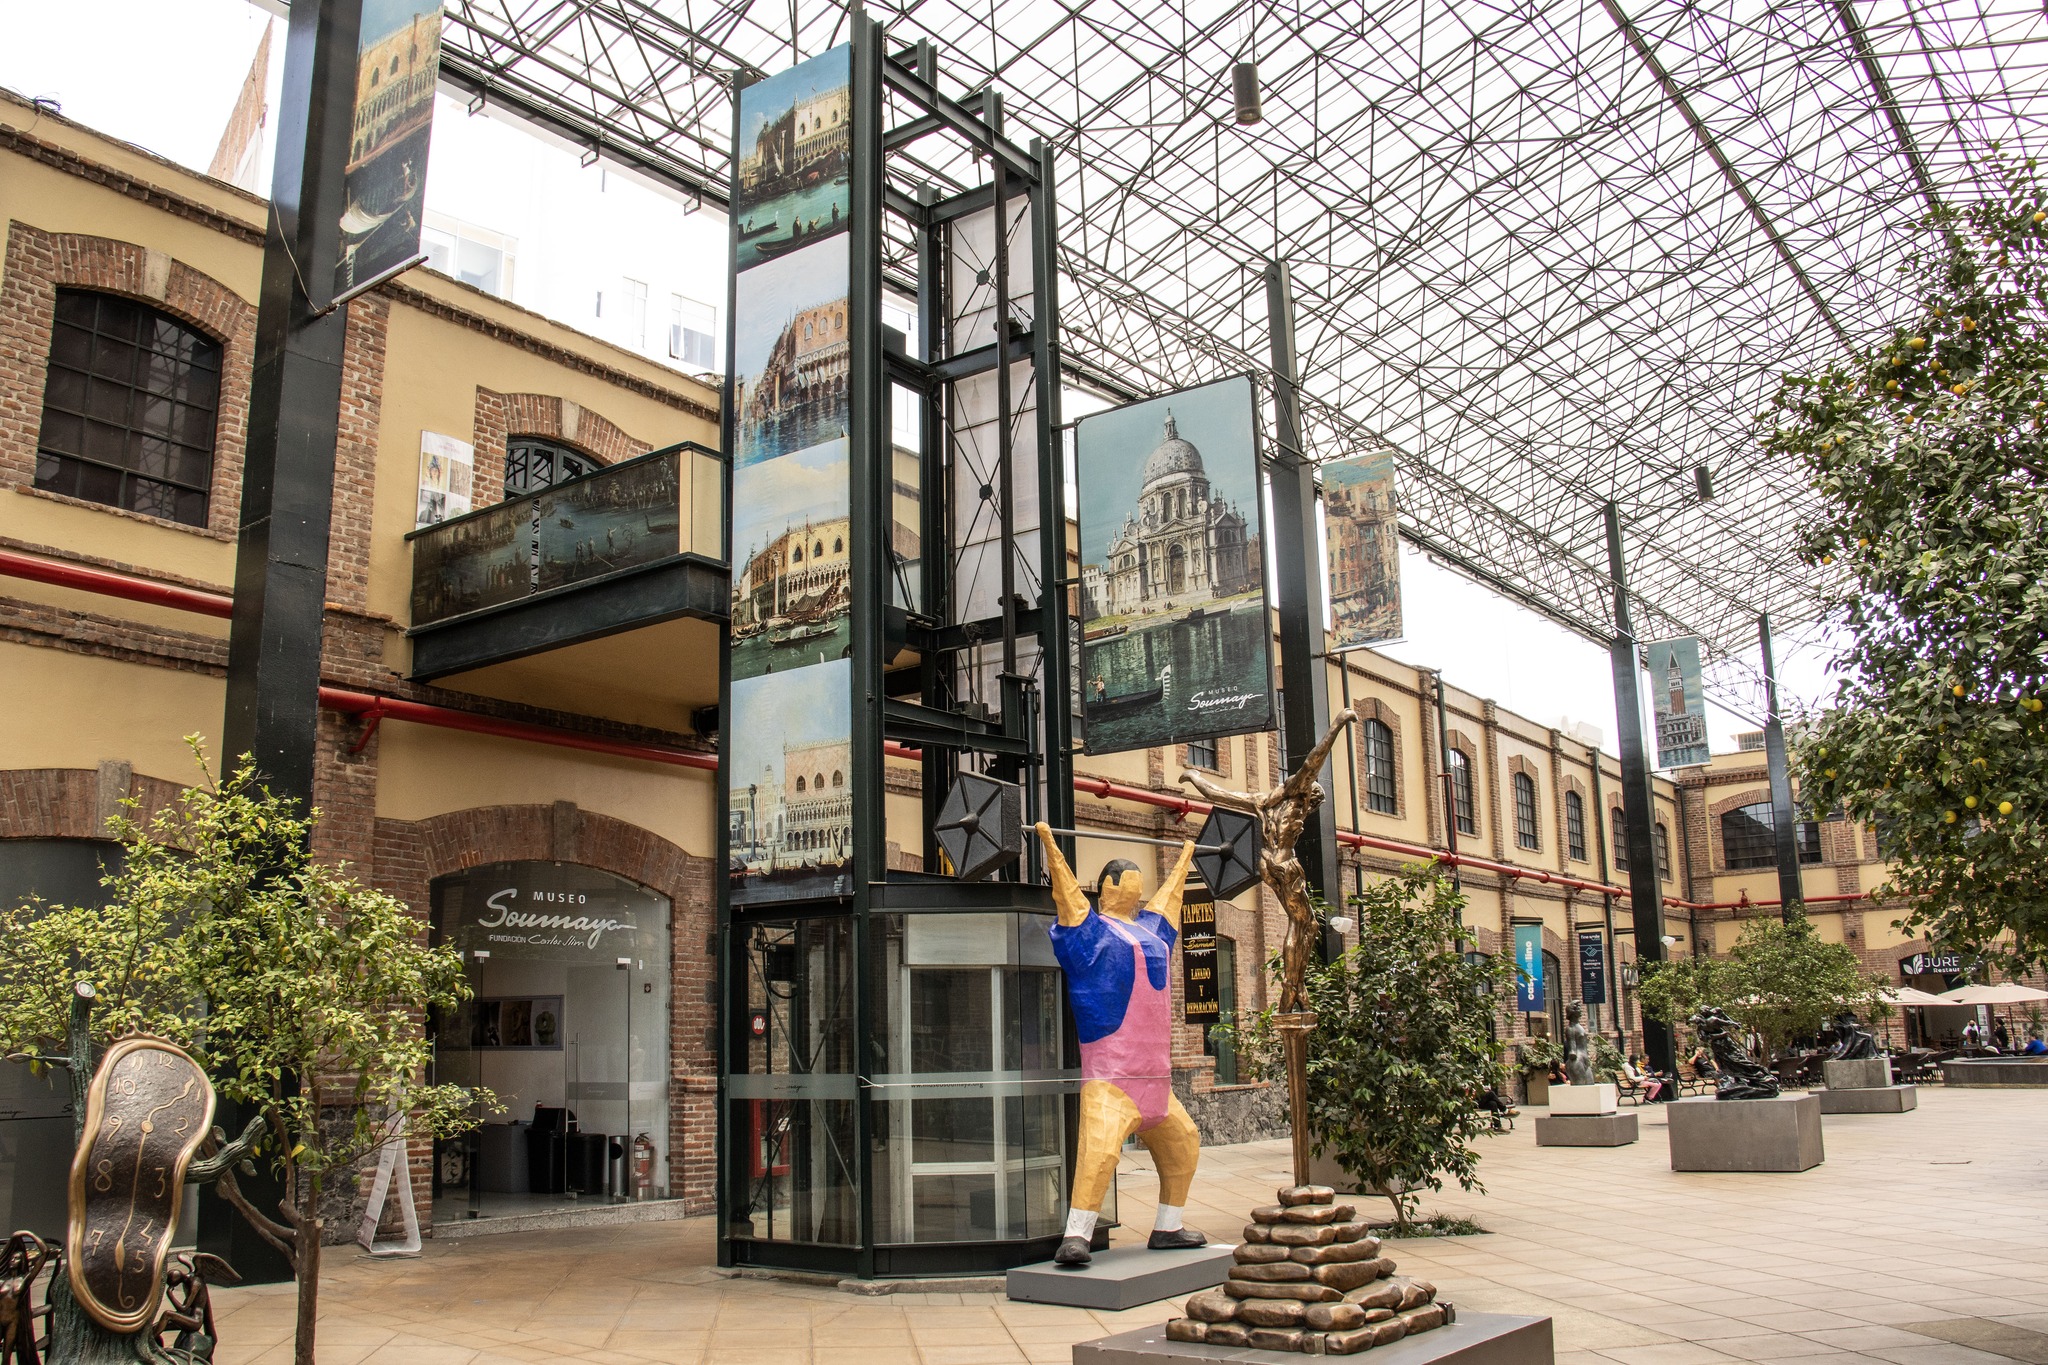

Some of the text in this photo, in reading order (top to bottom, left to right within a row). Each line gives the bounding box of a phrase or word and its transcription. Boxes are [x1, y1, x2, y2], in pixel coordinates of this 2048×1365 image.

[1208, 686, 1238, 695] MUSEO
[1187, 691, 1264, 711] Soumaya
[533, 891, 586, 904] MUSEO
[478, 888, 637, 950] Soumaya
[1182, 902, 1214, 923] TAPETES
[489, 934, 527, 944] FUNDACIÓN
[528, 934, 562, 946] Carlos
[1191, 968, 1211, 980] LAVADO
[1199, 985, 1204, 996] Y
[1186, 998, 1219, 1014] REPARACIÓN
[158, 1053, 175, 1070] 12
[115, 1077, 136, 1096] 10
[107, 1115, 122, 1142] 9
[174, 1117, 189, 1138] 2
[95, 1160, 112, 1191] 8
[153, 1167, 166, 1198] 3
[90, 1229, 104, 1257] 7
[133, 1250, 147, 1273] 5
